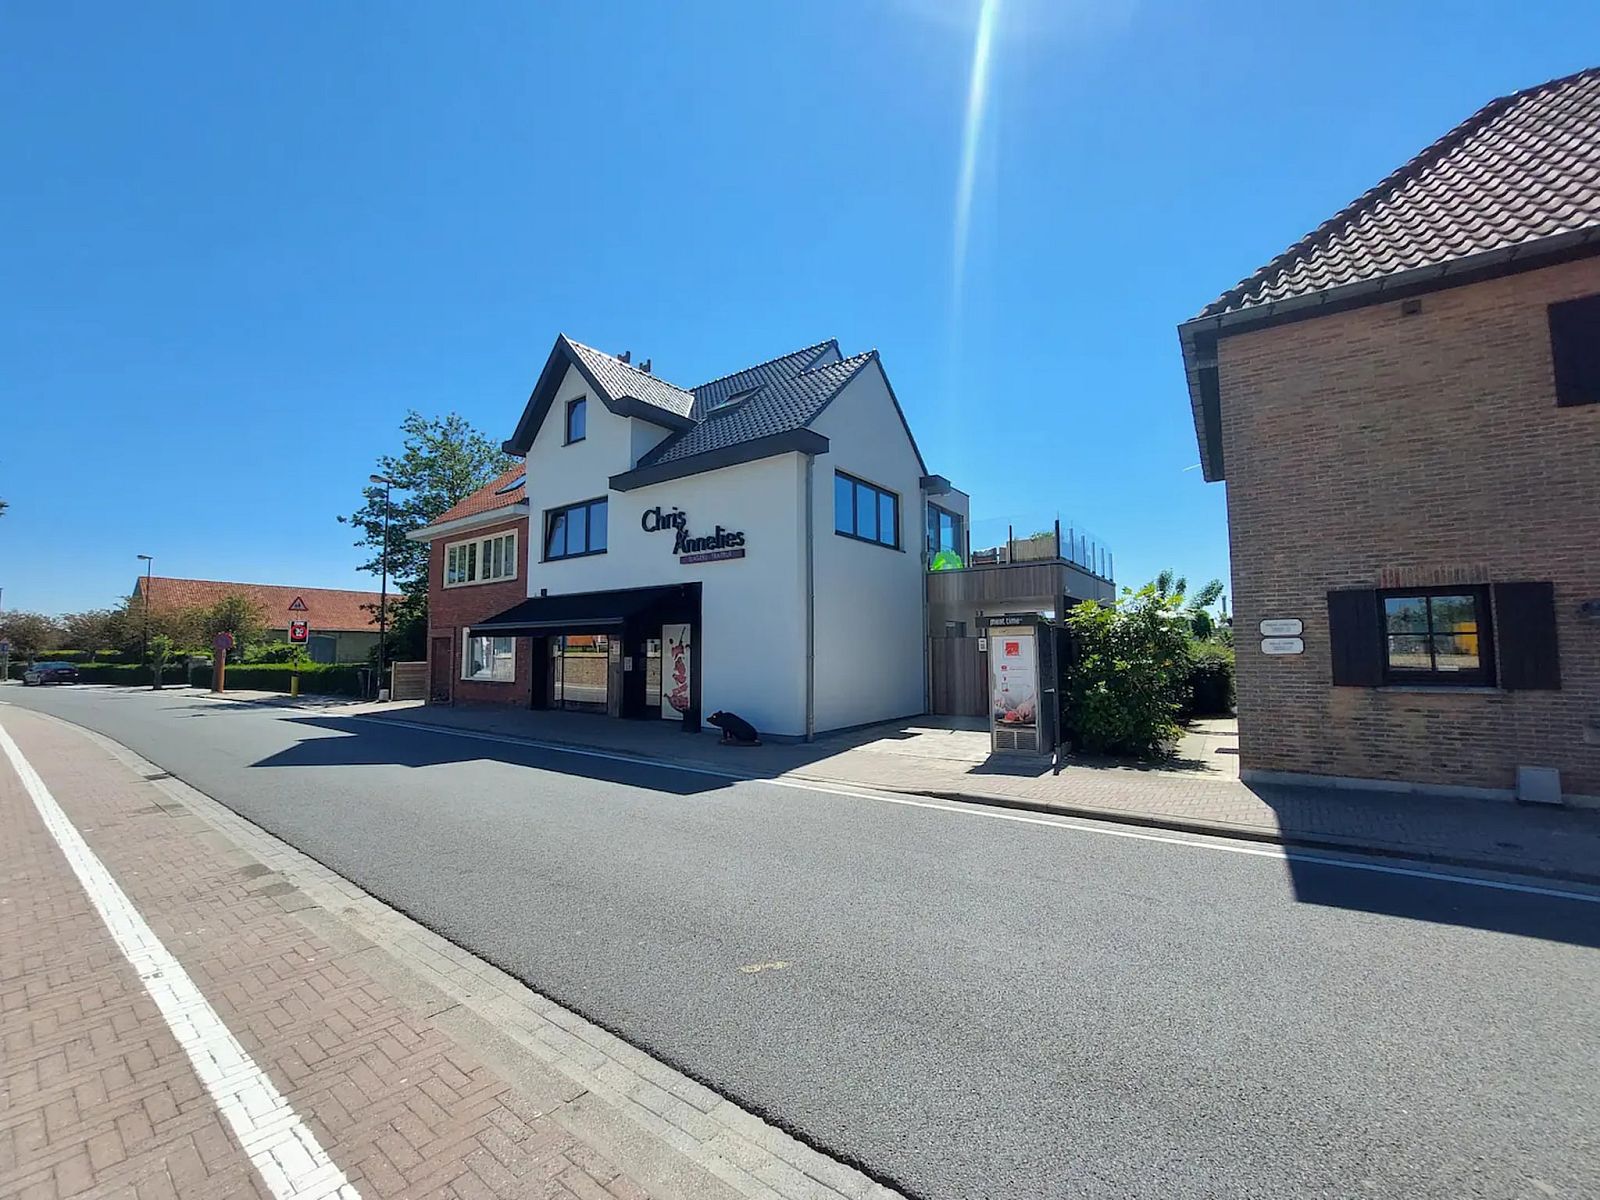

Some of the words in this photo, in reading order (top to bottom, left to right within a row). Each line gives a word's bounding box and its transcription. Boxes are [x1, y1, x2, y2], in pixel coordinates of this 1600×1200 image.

[641, 506, 687, 532] Chris
[672, 525, 746, 554] Annelies
[1006, 617, 1020, 625] time
